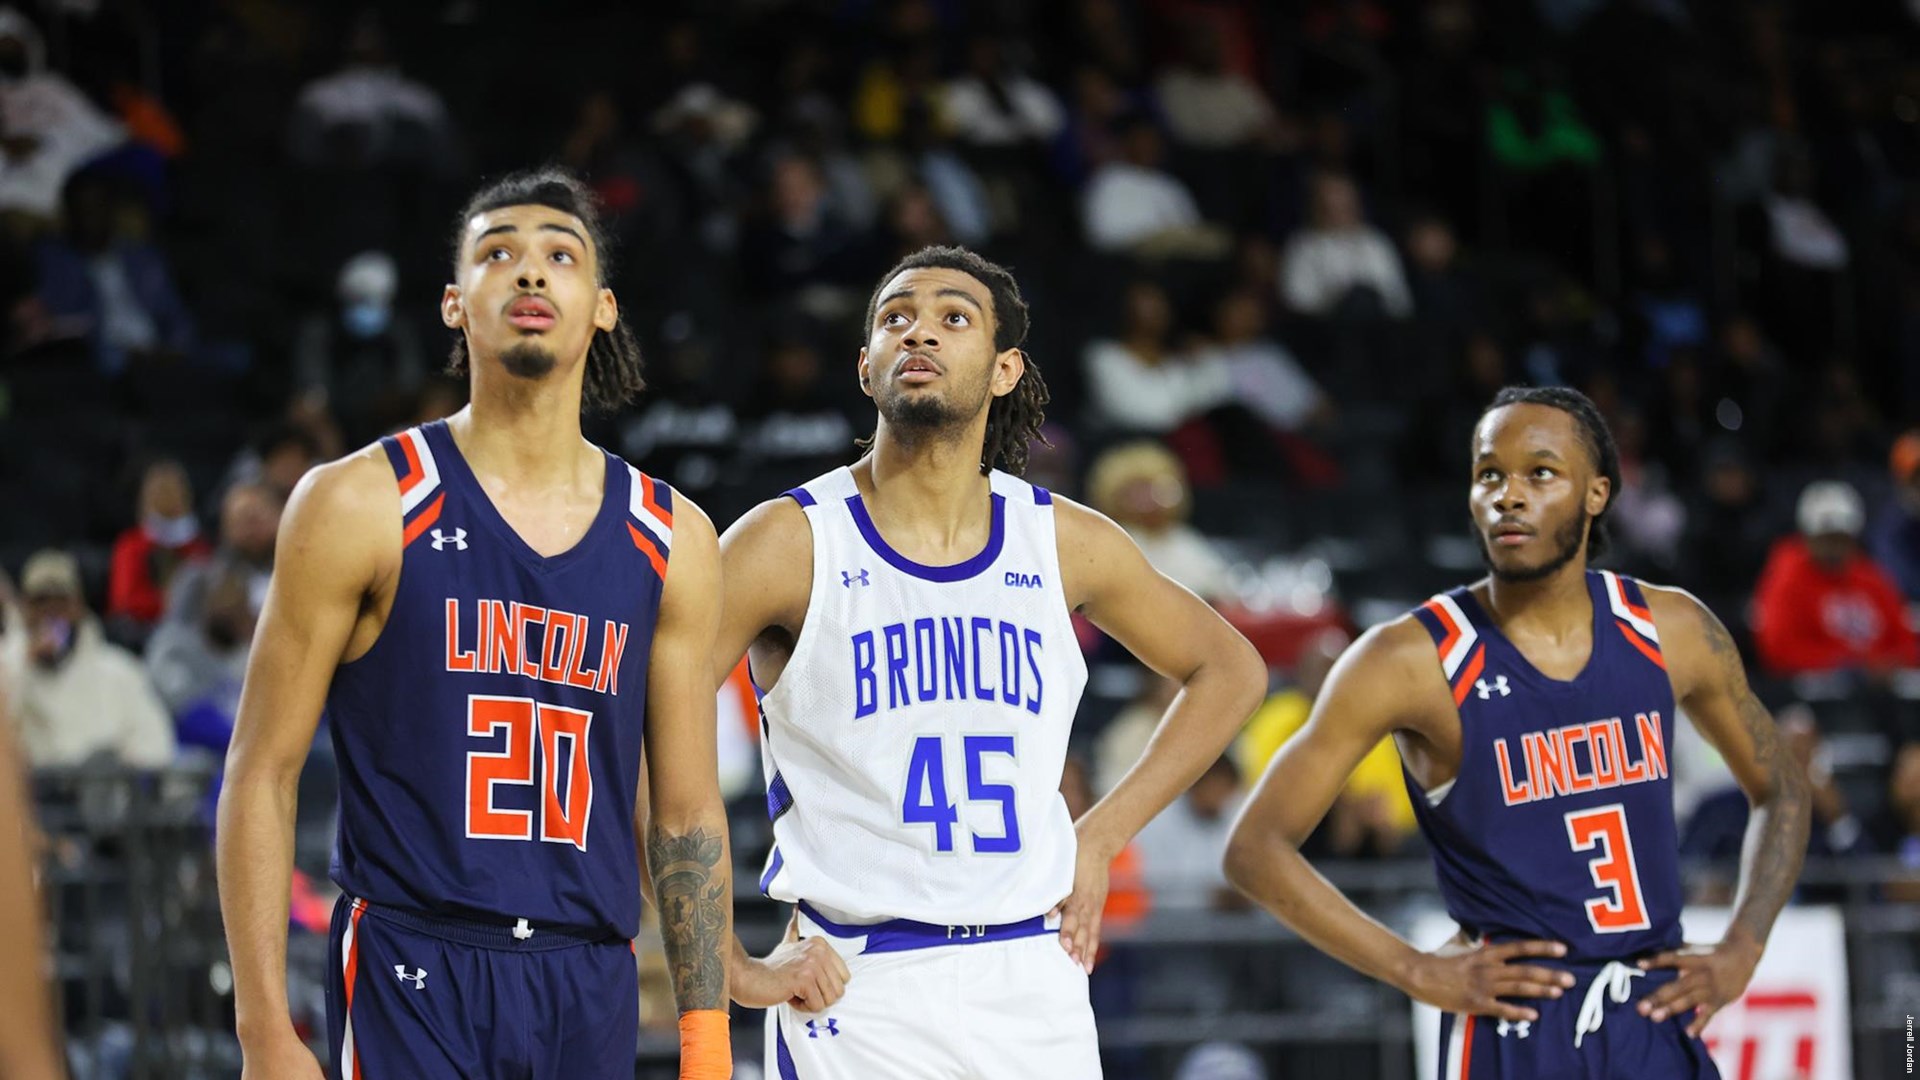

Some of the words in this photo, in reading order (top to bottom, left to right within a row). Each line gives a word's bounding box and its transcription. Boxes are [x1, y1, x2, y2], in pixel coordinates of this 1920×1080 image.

[1004, 571, 1043, 589] CIAA
[446, 598, 629, 695] LINCOLN
[850, 616, 1043, 720] BRONCOS
[465, 694, 593, 852] 20
[901, 733, 1023, 855] 45
[1494, 711, 1668, 806] LINCOLN
[1564, 802, 1651, 934] 3
